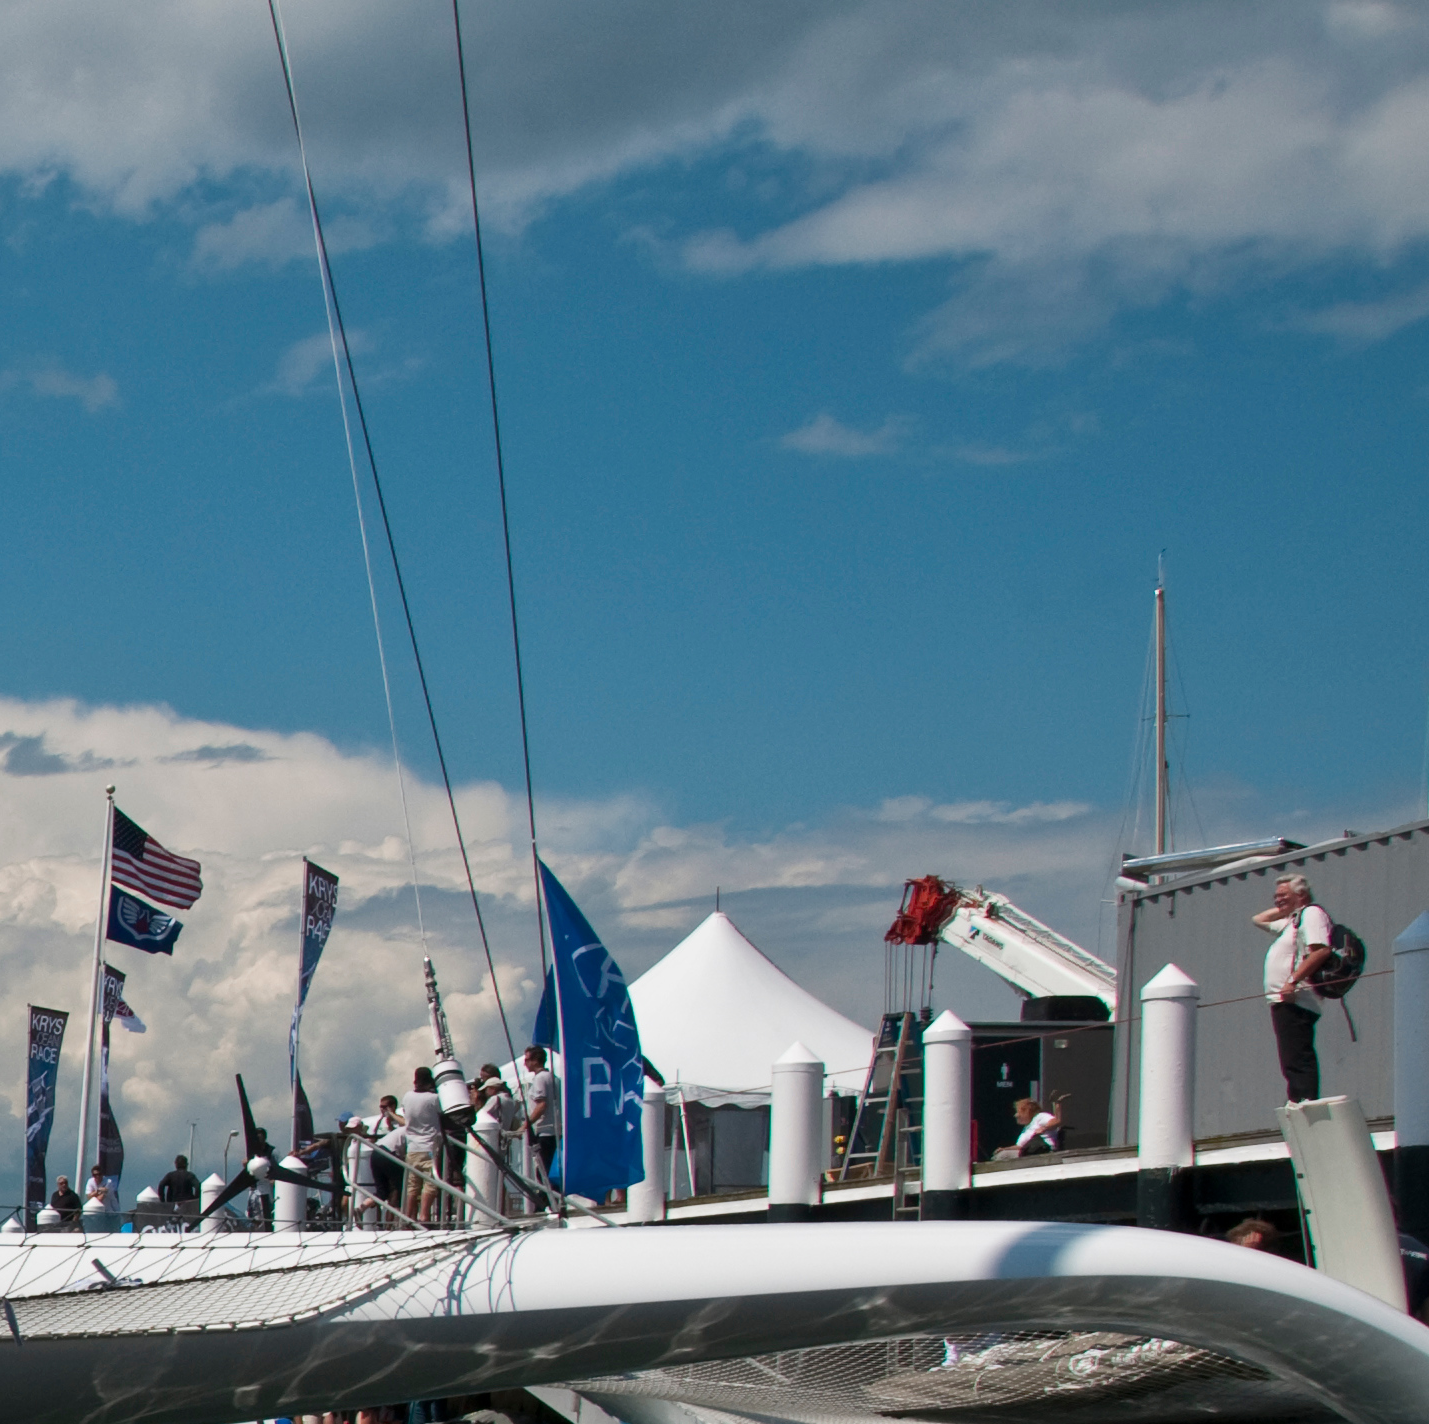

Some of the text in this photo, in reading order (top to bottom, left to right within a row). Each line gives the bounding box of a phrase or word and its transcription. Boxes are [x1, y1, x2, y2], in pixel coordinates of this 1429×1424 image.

[31, 1013, 64, 1035] KRYS
[32, 1031, 60, 1047] CEAN
[30, 1043, 58, 1064] RACE
